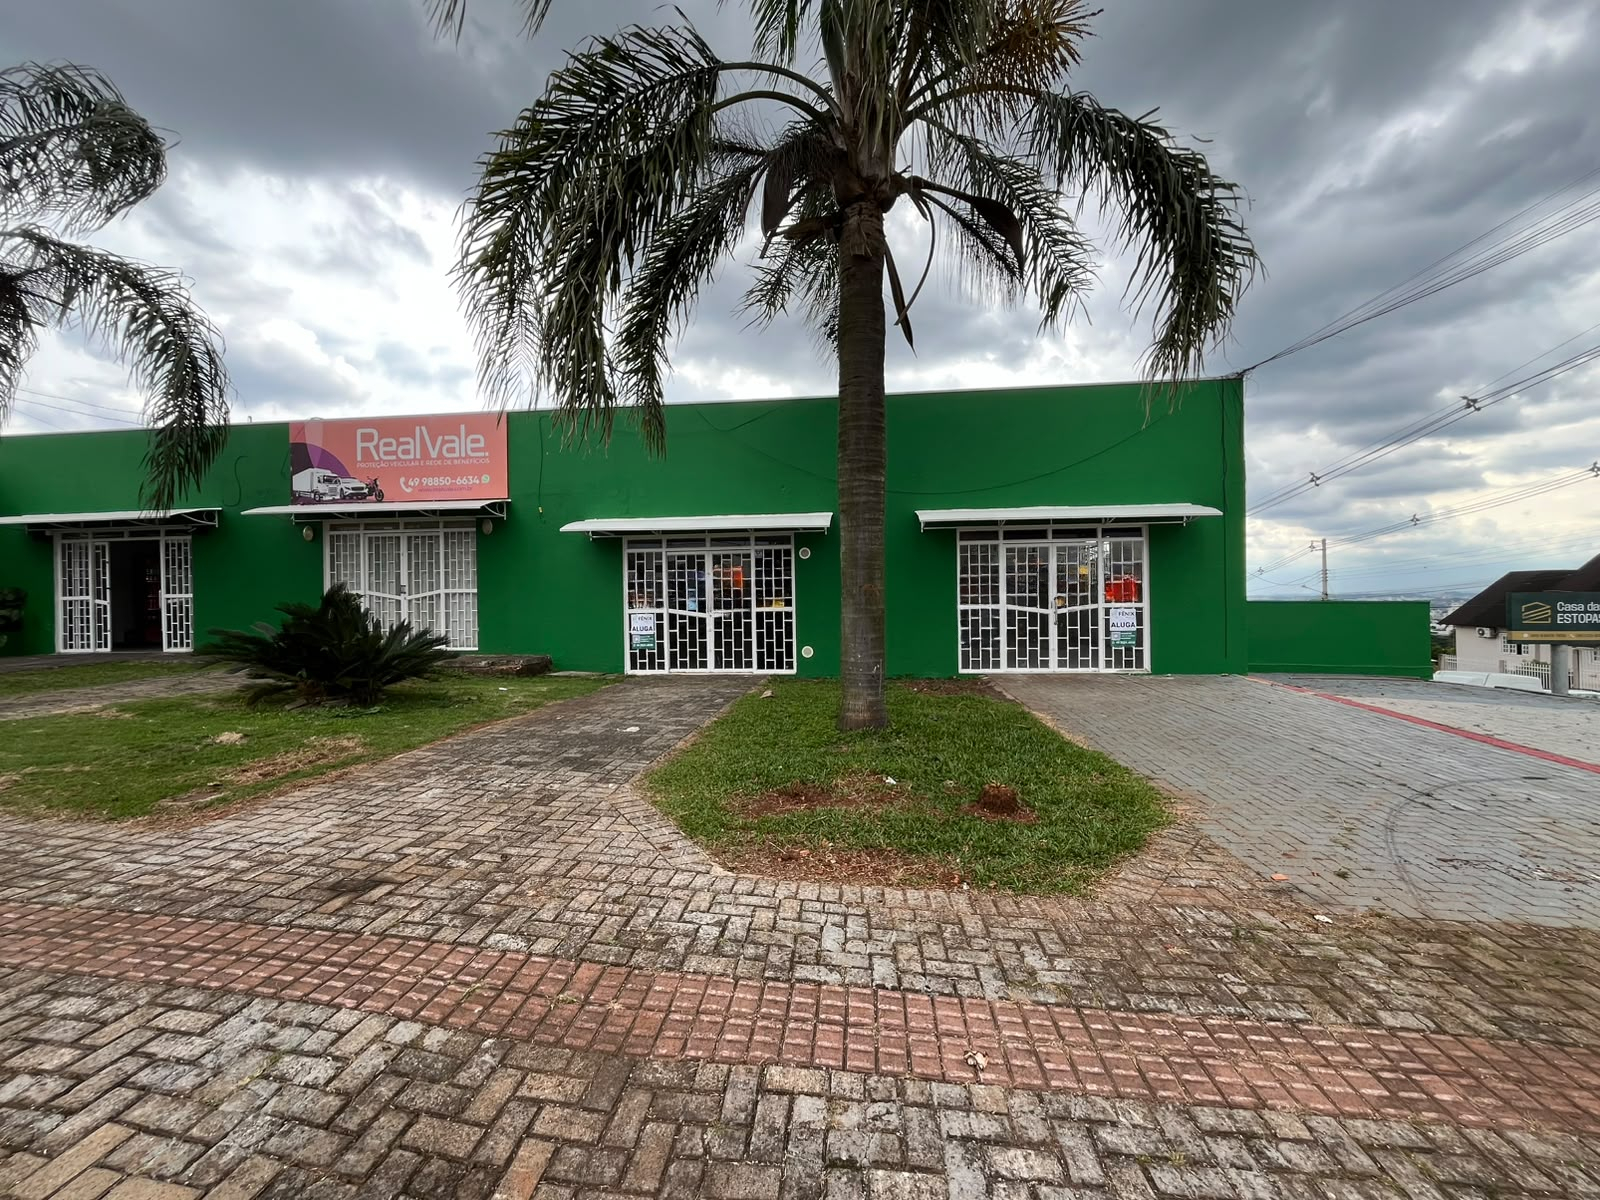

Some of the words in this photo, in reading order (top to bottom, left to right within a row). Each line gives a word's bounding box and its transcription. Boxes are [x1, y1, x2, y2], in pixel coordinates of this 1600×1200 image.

[357, 460, 389, 468] PROTEÇÃO
[408, 477, 419, 487] 49
[421, 475, 479, 486] 98850-6634
[1556, 601, 1585, 612] Casa
